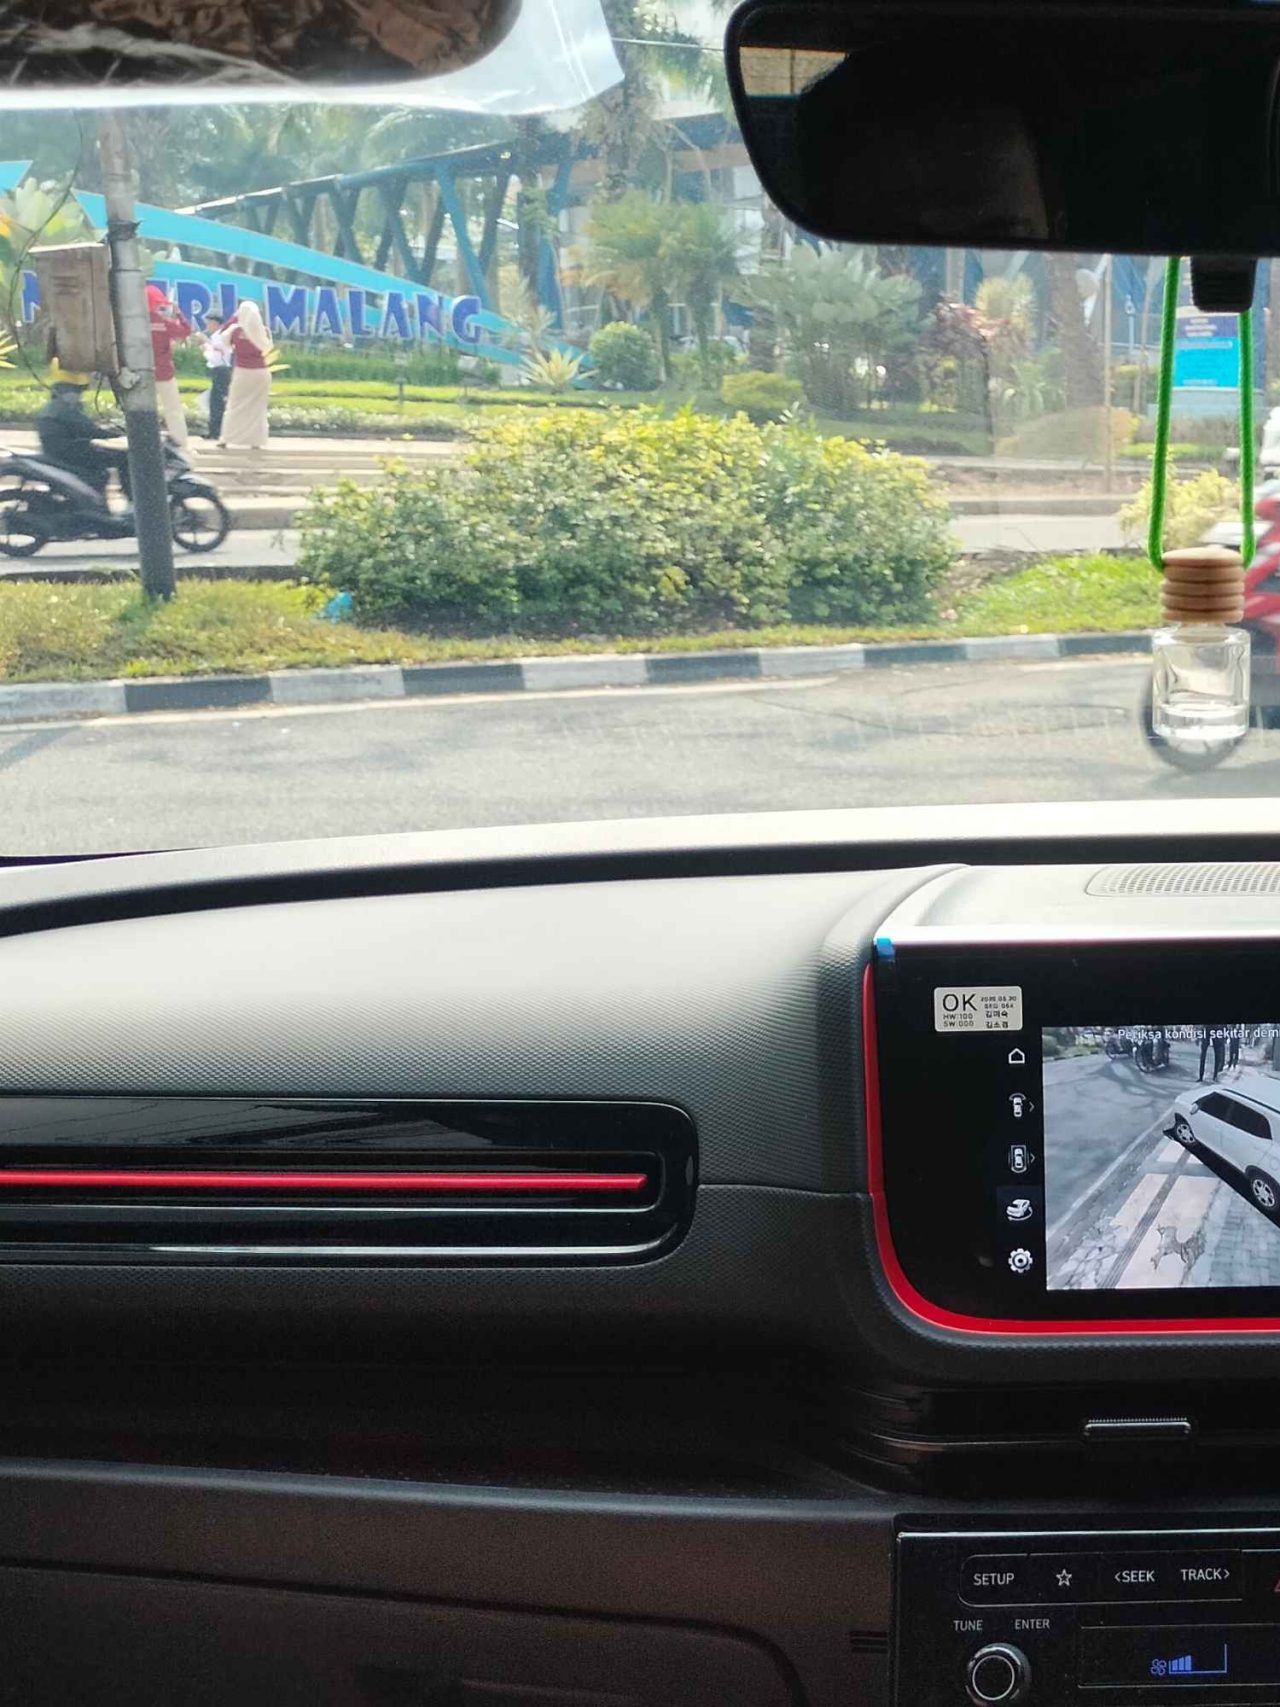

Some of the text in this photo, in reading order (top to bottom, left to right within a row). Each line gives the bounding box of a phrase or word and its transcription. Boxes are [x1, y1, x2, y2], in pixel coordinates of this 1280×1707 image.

[265, 284, 482, 344] MALANG
[942, 993, 978, 1012] OK
[1118, 1029, 1162, 1040] Periksa
[1165, 1029, 1207, 1040] kondisi
[1209, 1028, 1250, 1040] sekitar
[973, 1573, 1015, 1587] SETUP
[953, 1620, 983, 1632] TUNE
[1014, 1618, 1050, 1631] ENTER
